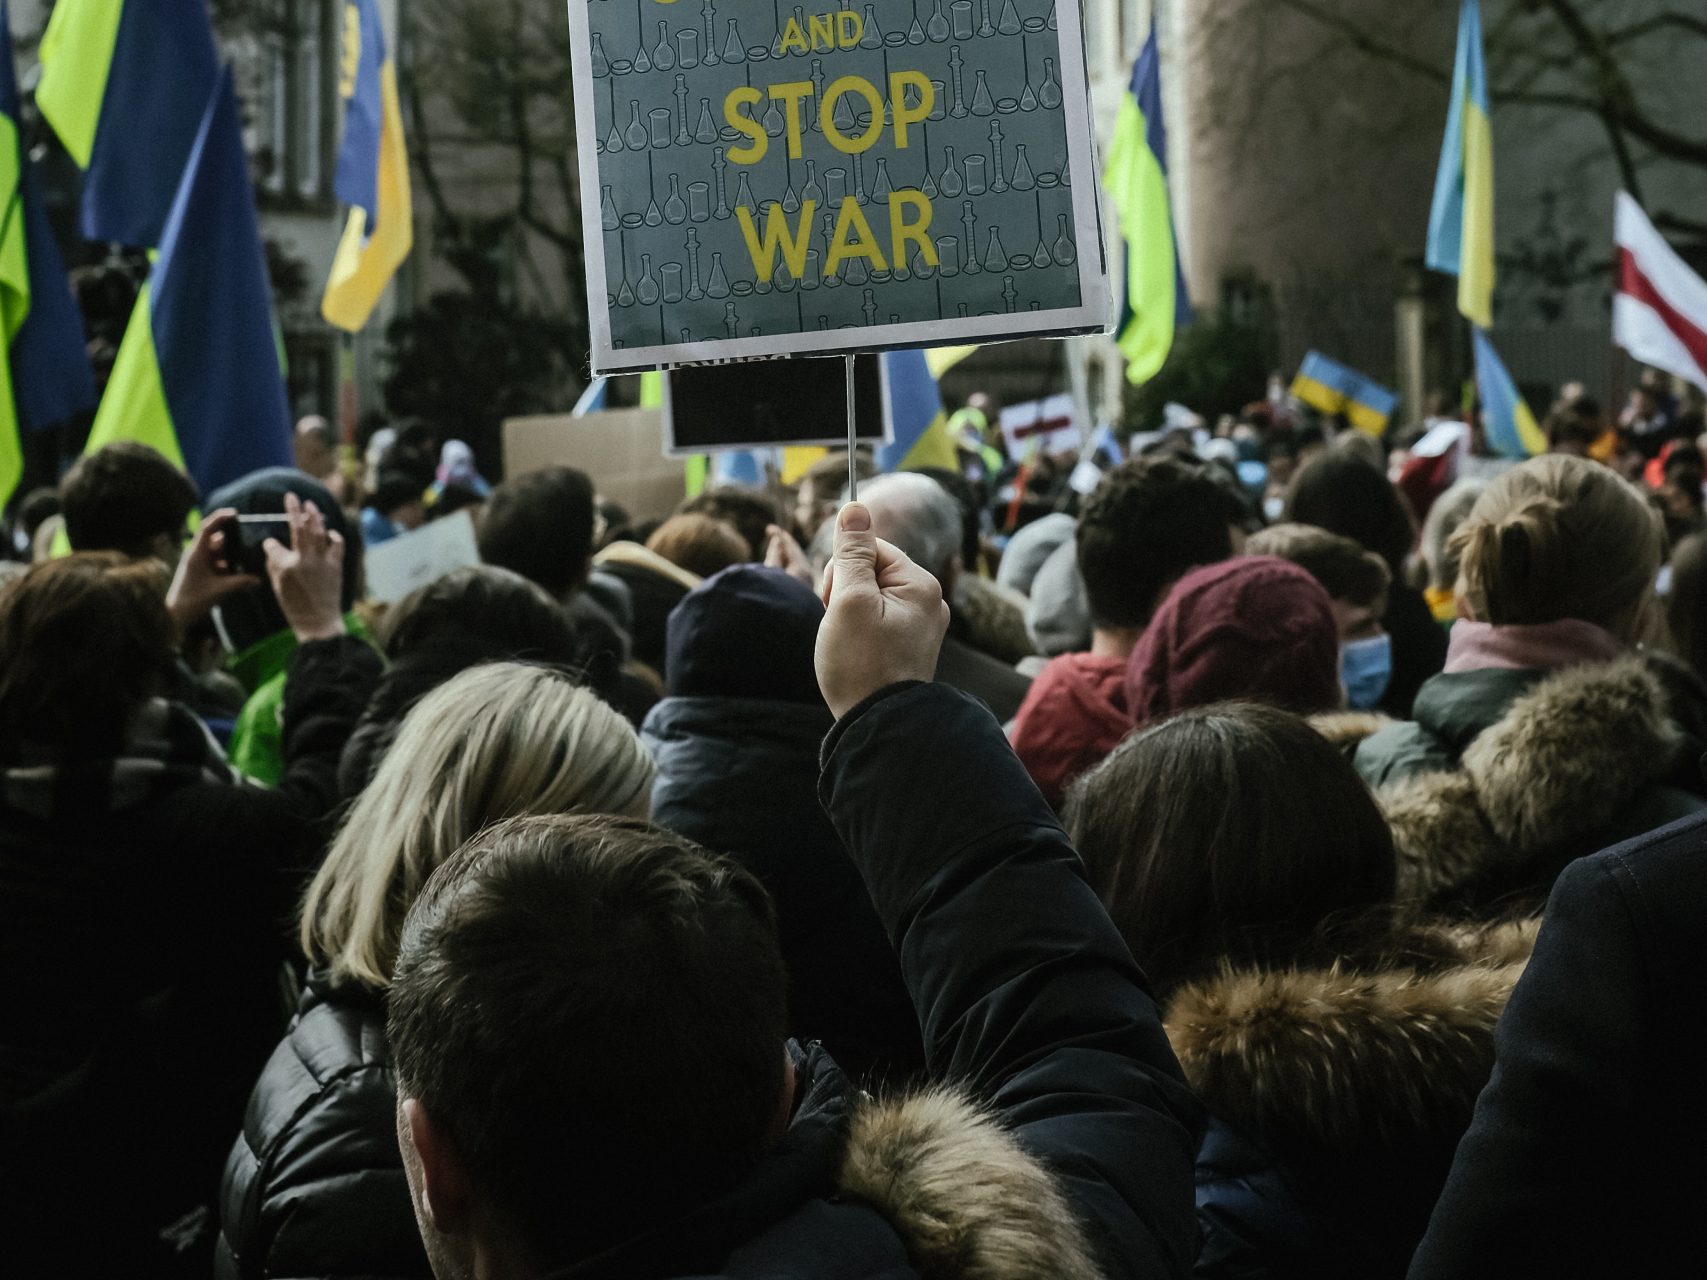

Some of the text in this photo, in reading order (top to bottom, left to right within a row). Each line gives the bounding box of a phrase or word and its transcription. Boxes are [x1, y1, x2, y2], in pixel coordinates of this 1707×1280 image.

[779, 11, 864, 53] AND
[723, 70, 935, 165] STOP
[735, 189, 939, 283] WAR
